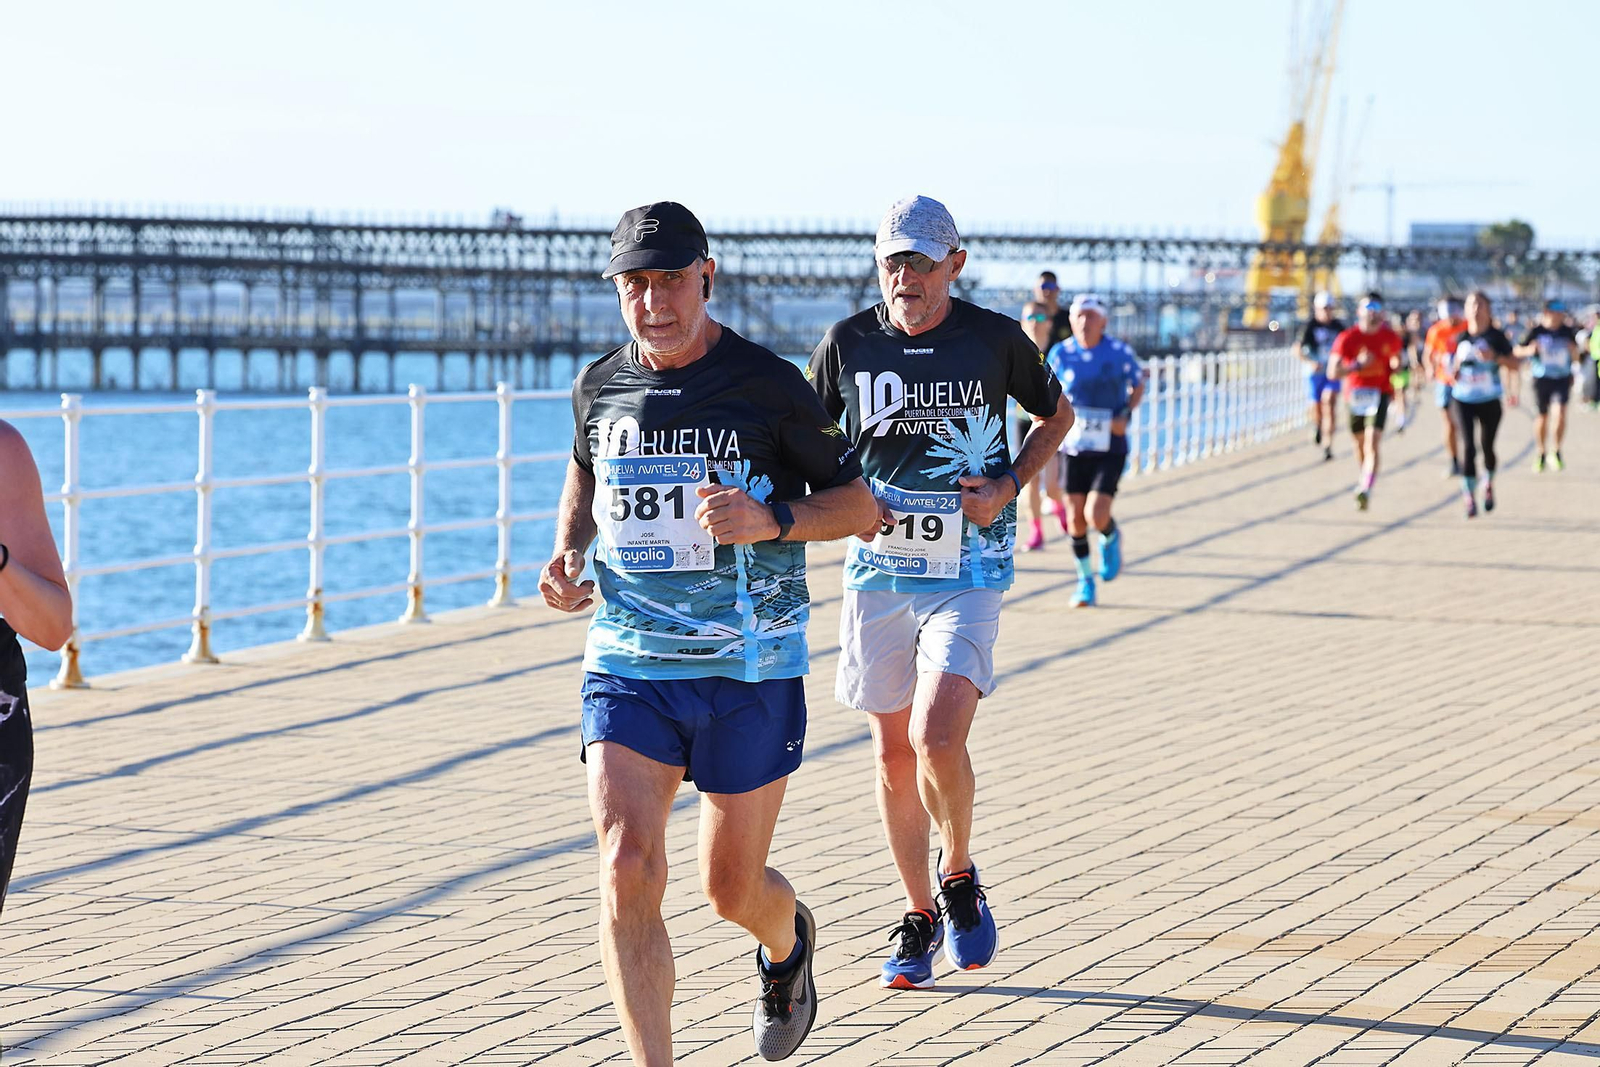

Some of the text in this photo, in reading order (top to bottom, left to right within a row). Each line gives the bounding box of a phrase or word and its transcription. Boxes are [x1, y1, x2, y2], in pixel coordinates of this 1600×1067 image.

[855, 371, 984, 437] 10 HUELVA
[905, 408, 926, 418] PUERTA
[926, 408, 937, 417] DEL
[896, 421, 956, 436] AVATEL
[641, 428, 741, 459] HUELVA
[610, 464, 635, 474] HUELVA
[638, 465, 678, 474] AVATEL
[610, 485, 684, 522] 581
[903, 498, 936, 506] AVATEL
[873, 552, 920, 568] Wayalia
